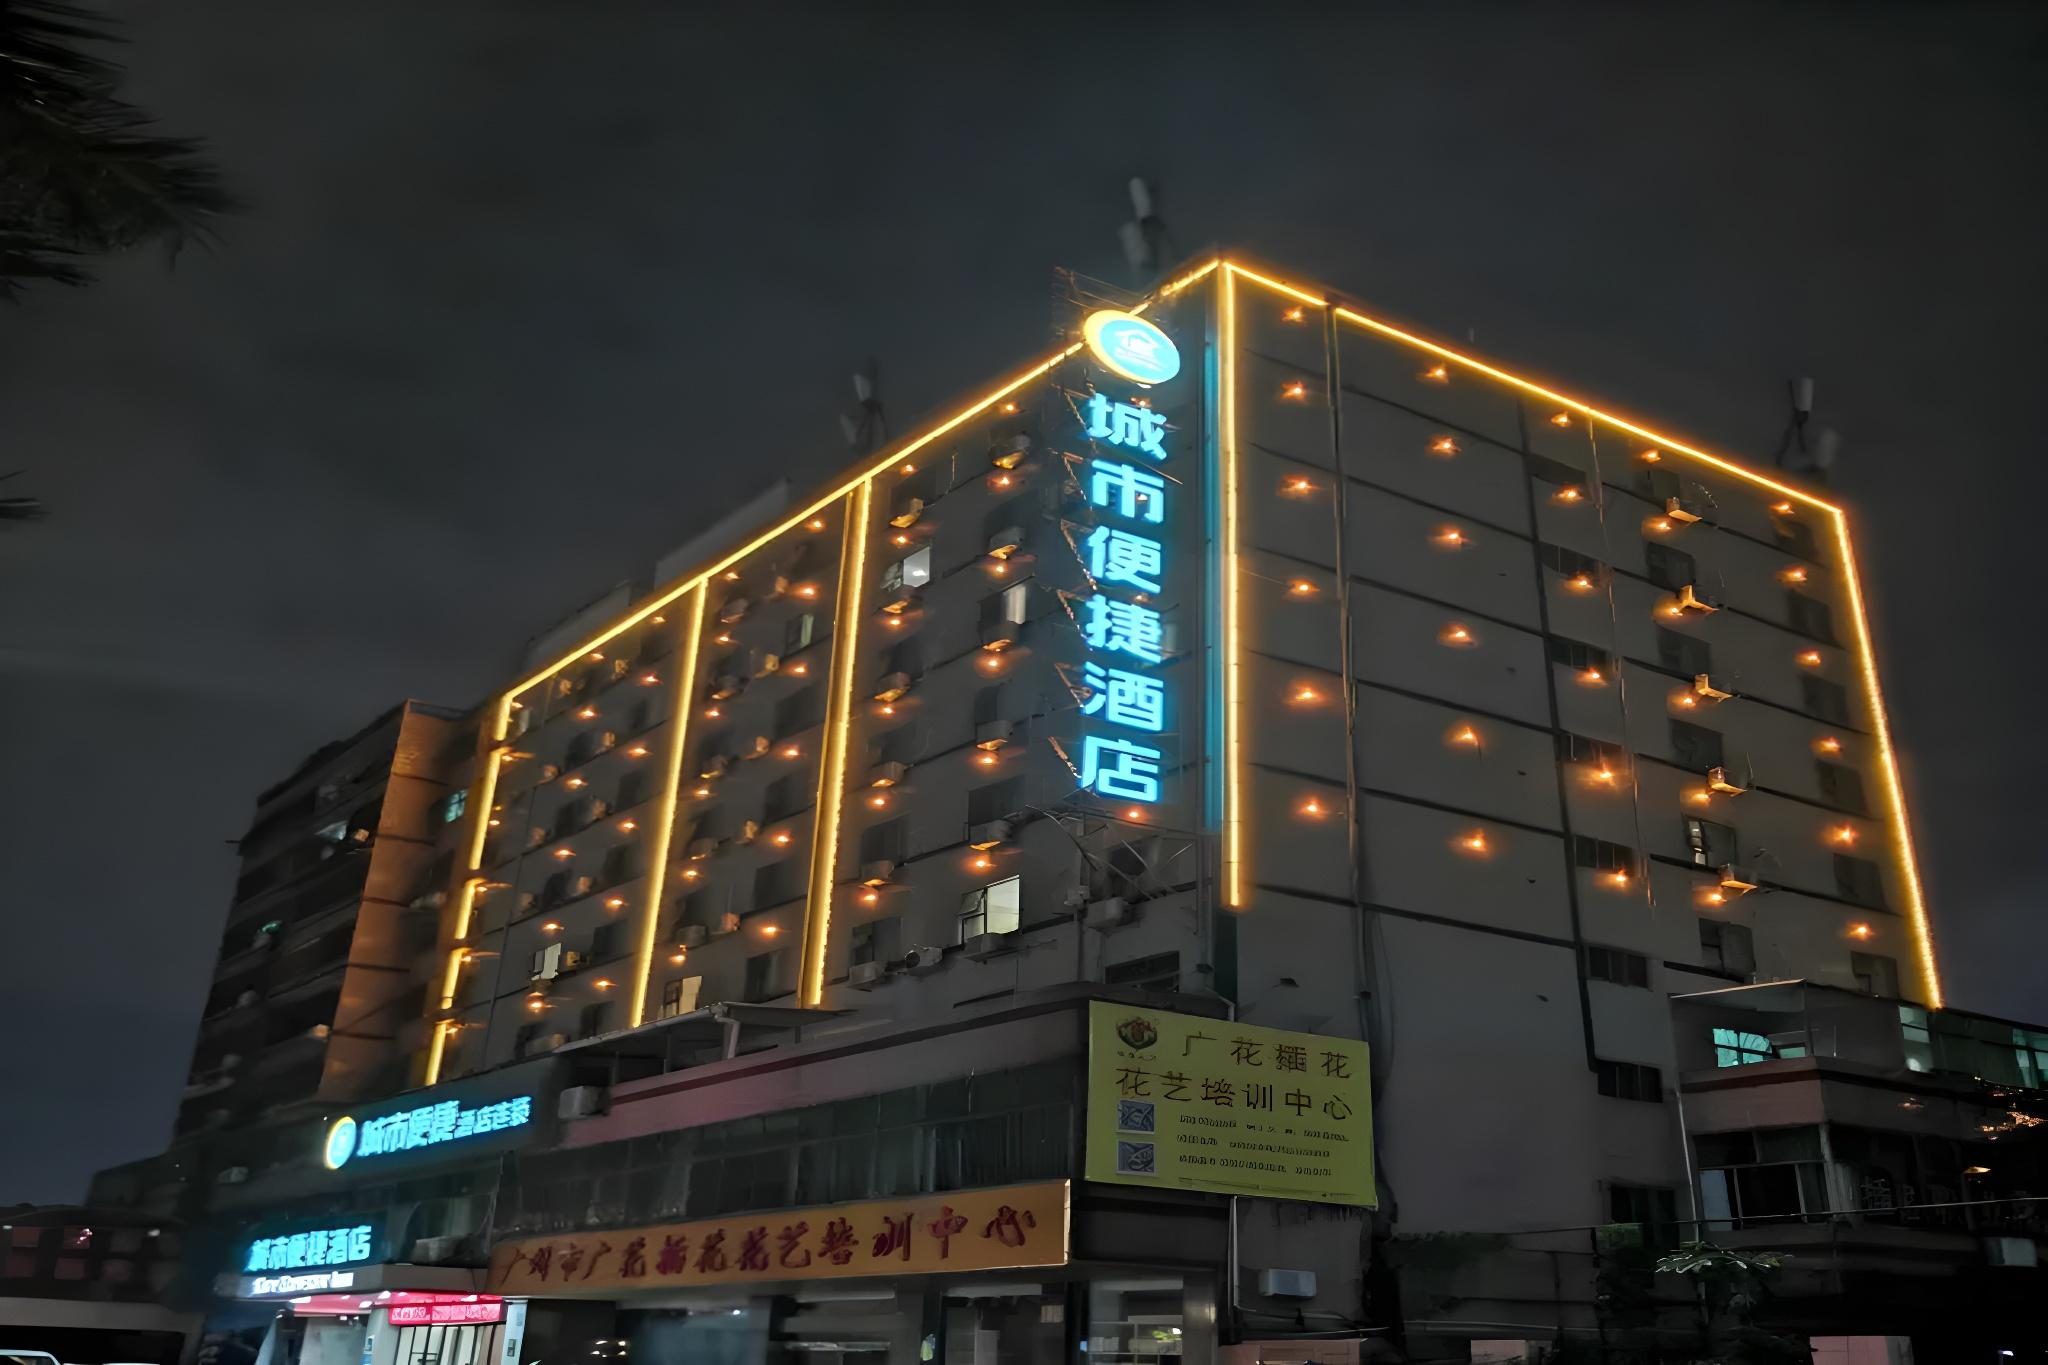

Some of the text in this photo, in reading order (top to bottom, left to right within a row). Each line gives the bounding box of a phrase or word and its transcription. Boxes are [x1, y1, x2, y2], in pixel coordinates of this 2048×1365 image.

[1081, 392, 1167, 804] 城市便捷酒店
[1115, 1067, 1353, 1121] 花艺培训中心
